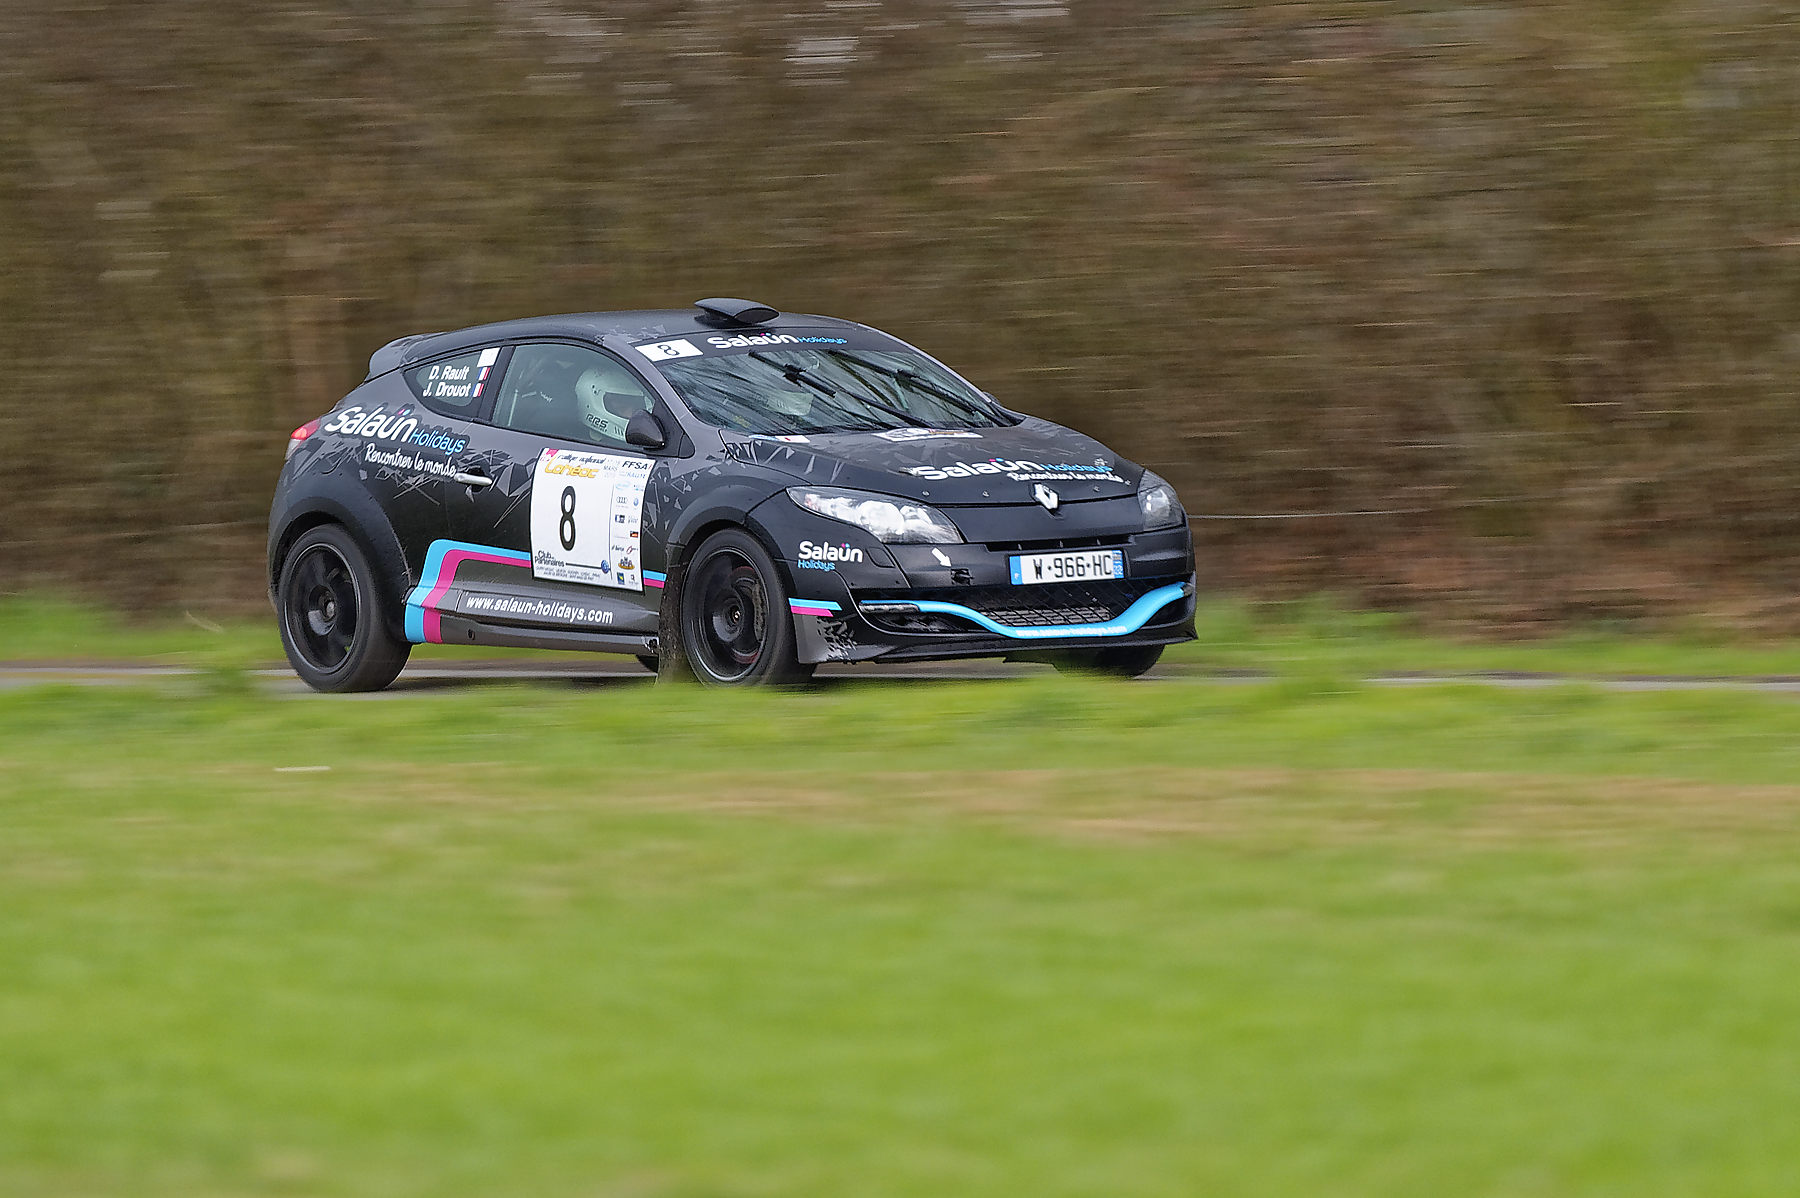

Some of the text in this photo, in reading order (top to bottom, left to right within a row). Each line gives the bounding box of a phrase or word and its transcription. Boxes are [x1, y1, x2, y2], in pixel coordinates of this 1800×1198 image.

[657, 344, 680, 356] 8
[707, 333, 848, 349] Salaün Holidays
[429, 366, 470, 381] D. Rault
[423, 382, 471, 397] J. Drouot
[324, 406, 466, 455] Salaün Holidays
[586, 413, 608, 429] RRS
[364, 443, 457, 478] Rencontrer le monde
[622, 460, 648, 470] FFSA
[915, 458, 1045, 480] Salaün
[560, 486, 576, 551] 8
[797, 540, 864, 572] Salaün Holidays
[466, 596, 613, 624] www.salaun-holidays.com
